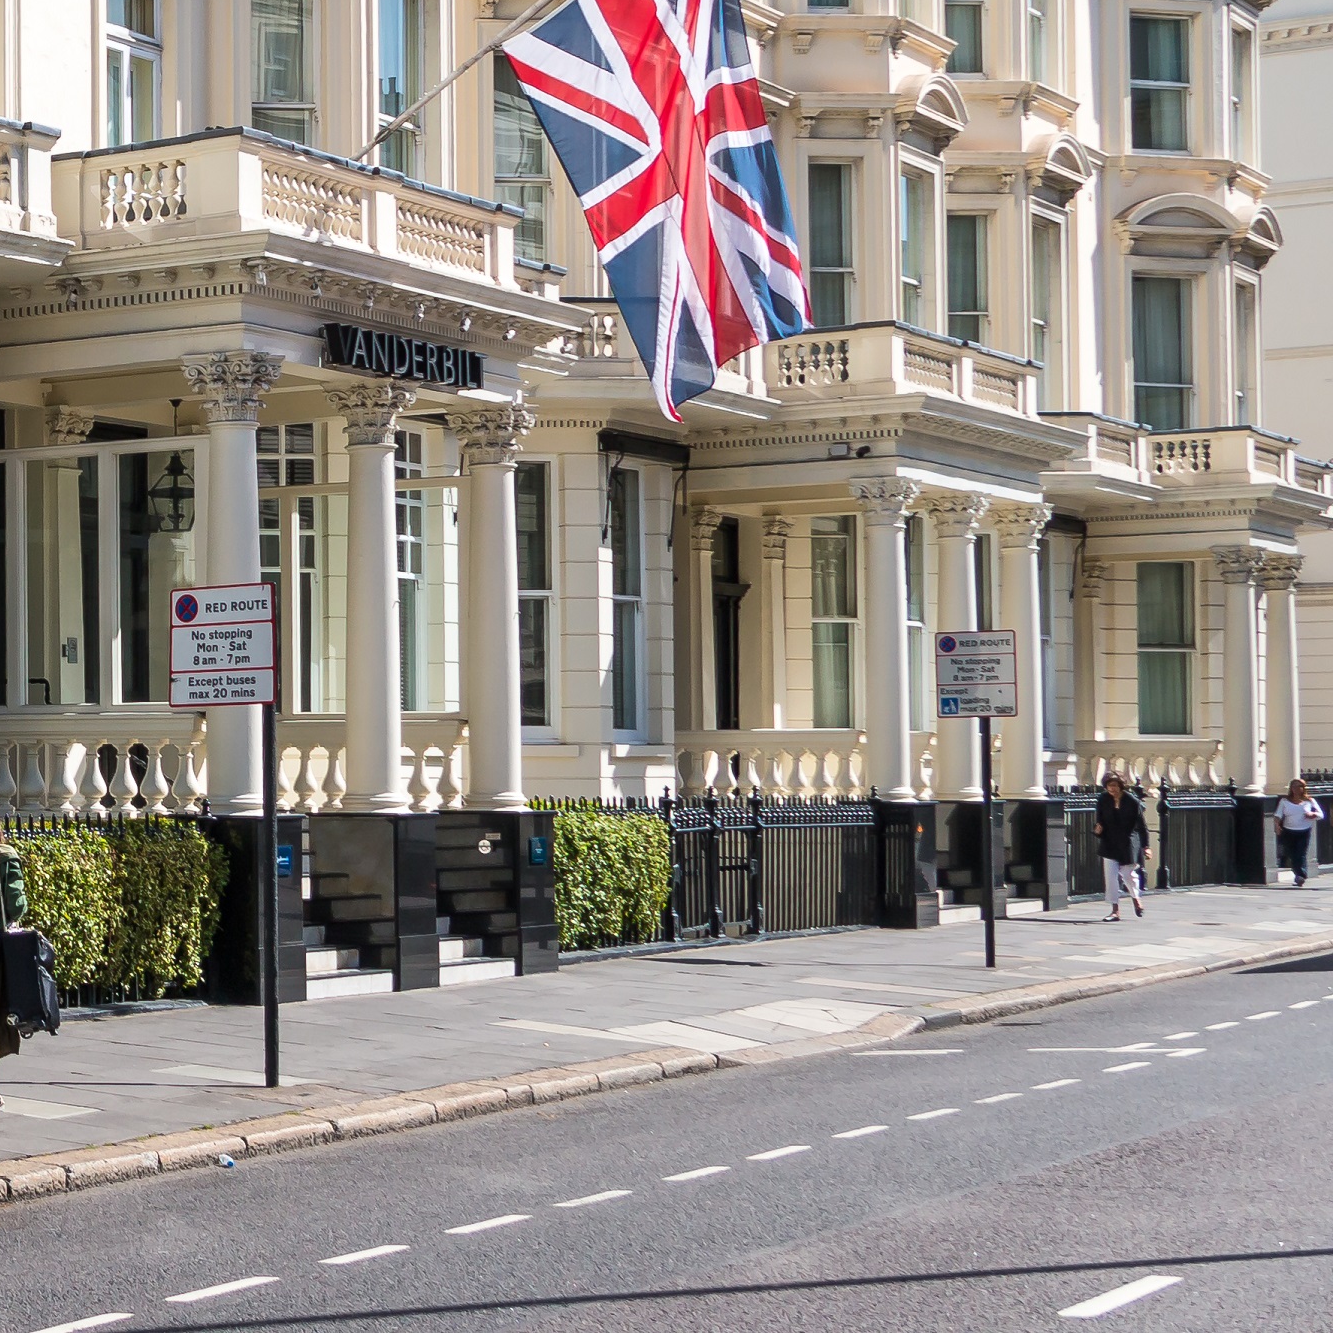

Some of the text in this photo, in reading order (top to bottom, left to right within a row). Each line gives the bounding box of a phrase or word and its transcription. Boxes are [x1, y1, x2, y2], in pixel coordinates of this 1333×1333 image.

[323, 323, 489, 389] VANDERBILT
[205, 599, 268, 613] RED ROUTE
[191, 628, 253, 641] No stopping
[196, 642, 219, 653] Mon
[229, 641, 247, 651] Sat
[958, 639, 1011, 648] RED ROUTE
[965, 657, 1001, 665] stopping
[188, 675, 256, 687] Except buses
[189, 687, 256, 700] max 20 mins
[960, 697, 990, 705] loading
